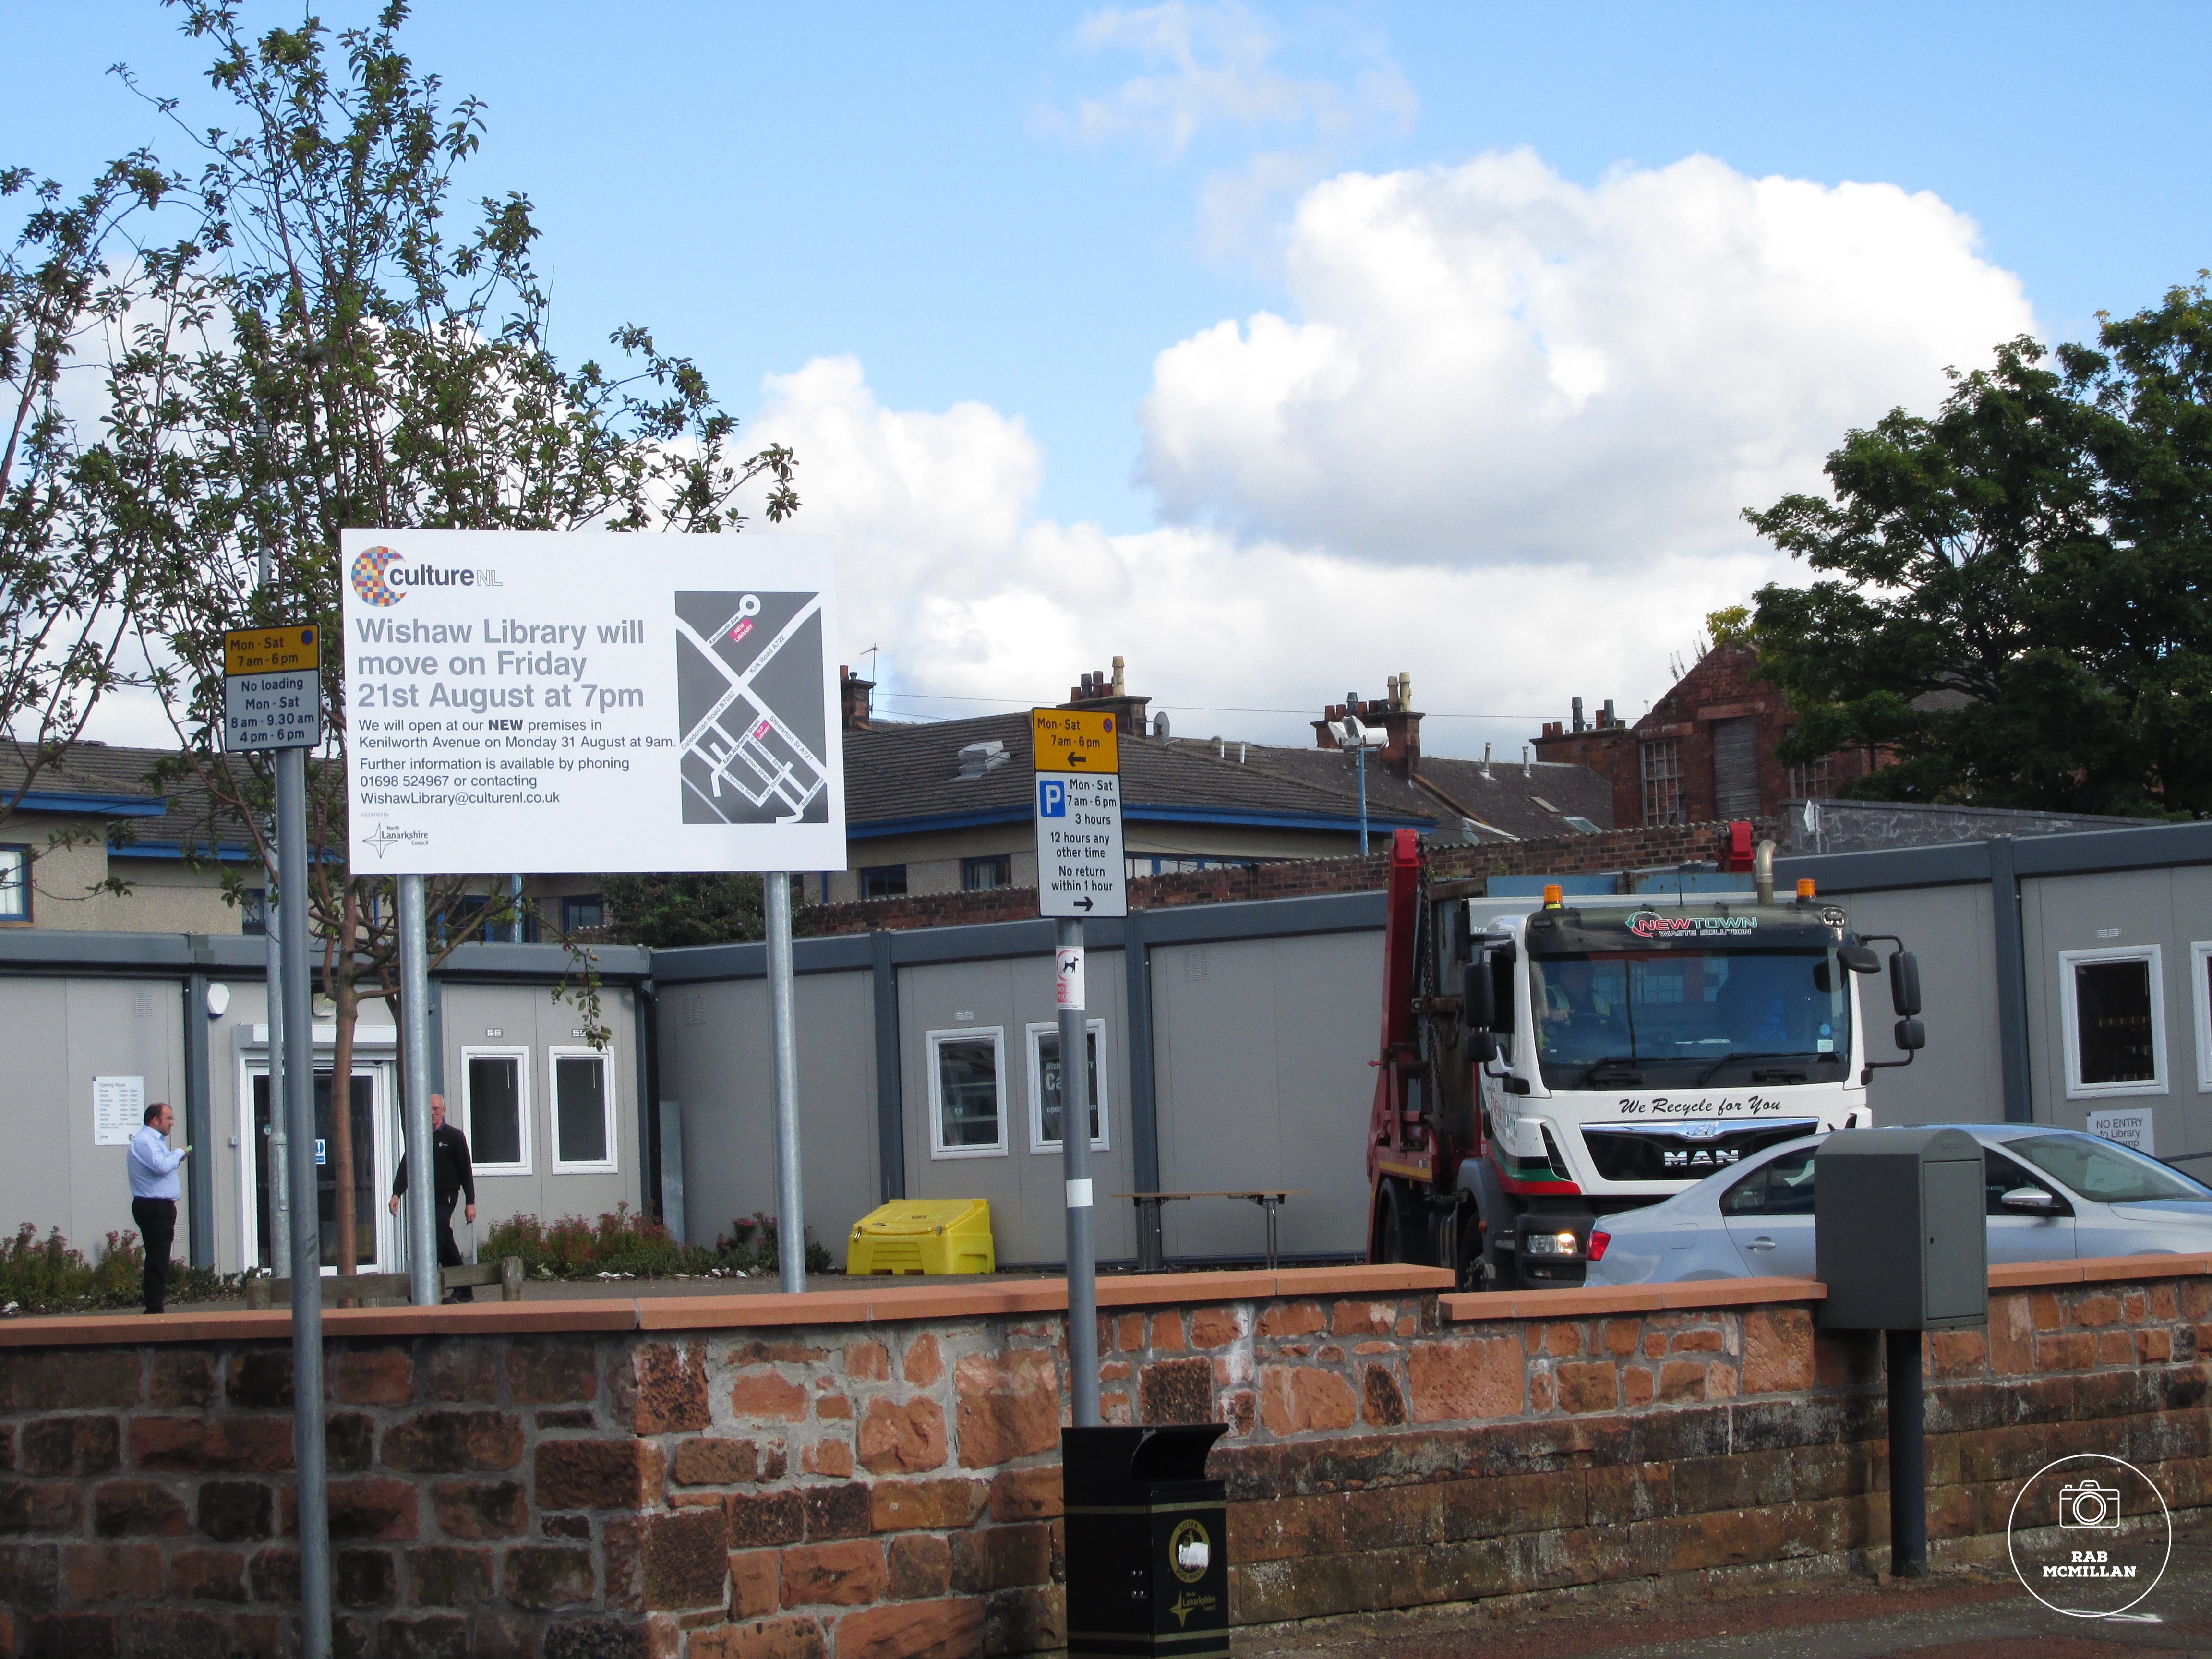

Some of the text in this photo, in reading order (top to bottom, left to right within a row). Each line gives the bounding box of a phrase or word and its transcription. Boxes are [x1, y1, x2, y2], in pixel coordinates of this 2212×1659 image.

[356, 618, 644, 650] Wishaw Library will
[733, 623, 745, 634] NEW
[734, 624, 753, 642] LIBRARY
[230, 640, 254, 651] Mon
[264, 637, 284, 648] Sat
[238, 656, 244, 667] 7
[247, 657, 263, 666] am
[272, 653, 278, 664] 6
[281, 654, 298, 665] pm
[749, 635, 785, 674] Kirk Road A722
[359, 651, 587, 682] move on Friday
[242, 678, 303, 692] No loading
[246, 699, 269, 710] Mon
[279, 696, 299, 708] Sat
[359, 683, 644, 713] 21st August at 7pm
[231, 717, 238, 728] 8
[241, 719, 257, 728] am
[267, 712, 294, 726] 9.30
[298, 714, 313, 723] am
[359, 720, 602, 733] We will open at our NEW premises in
[681, 691, 735, 750] Caledonian Road B7032
[1037, 718, 1057, 729] Mon
[1064, 719, 1080, 730] Sat
[240, 731, 248, 742] 4
[251, 733, 267, 743] pm
[277, 729, 284, 740] 6
[288, 730, 304, 741] pm
[360, 736, 676, 750] Kenilworth Avenue on Monday 31 August at 9am.
[723, 720, 760, 764] East Academy Street
[769, 715, 814, 762] Stewarton St A721
[1051, 735, 1056, 746] 7
[1058, 737, 1071, 747] am
[1079, 736, 1084, 747] 6
[1087, 739, 1100, 749] pm
[361, 758, 629, 772] Further information is available by phoning
[740, 750, 770, 782] Leighton Street
[772, 759, 785, 772] Street
[361, 775, 537, 789] 01698 524967 or contacting
[770, 774, 782, 788] Street
[812, 777, 825, 792] Street
[1070, 779, 1089, 790] Mon
[1097, 780, 1113, 791] Sat
[361, 792, 560, 806] WishawLibrary@culturenl.co.uk
[745, 789, 758, 802] Street
[1067, 795, 1072, 805] 7
[1074, 797, 1087, 806] am
[1095, 796, 1100, 806] 6
[1103, 799, 1117, 809] pm
[1075, 814, 1111, 825] 3 hours
[382, 830, 428, 840] Lanarkshire
[1050, 832, 1109, 845] 12 hours any
[1057, 846, 1106, 857] other time
[1059, 866, 1105, 877] No return
[1052, 881, 1113, 891] within 1 hour
[1619, 1095, 1781, 1116] We Recycle for You
[2096, 1118, 2143, 1128] NO ENTRY
[2111, 1129, 2140, 1139] Library
[2120, 1140, 2139, 1148] amp
[1664, 1150, 1739, 1166] MAN
[1180, 1521, 1198, 1531] LITTER
[1176, 1568, 1188, 1580] DOG
[1183, 1595, 1216, 1606] Lanarkshire
